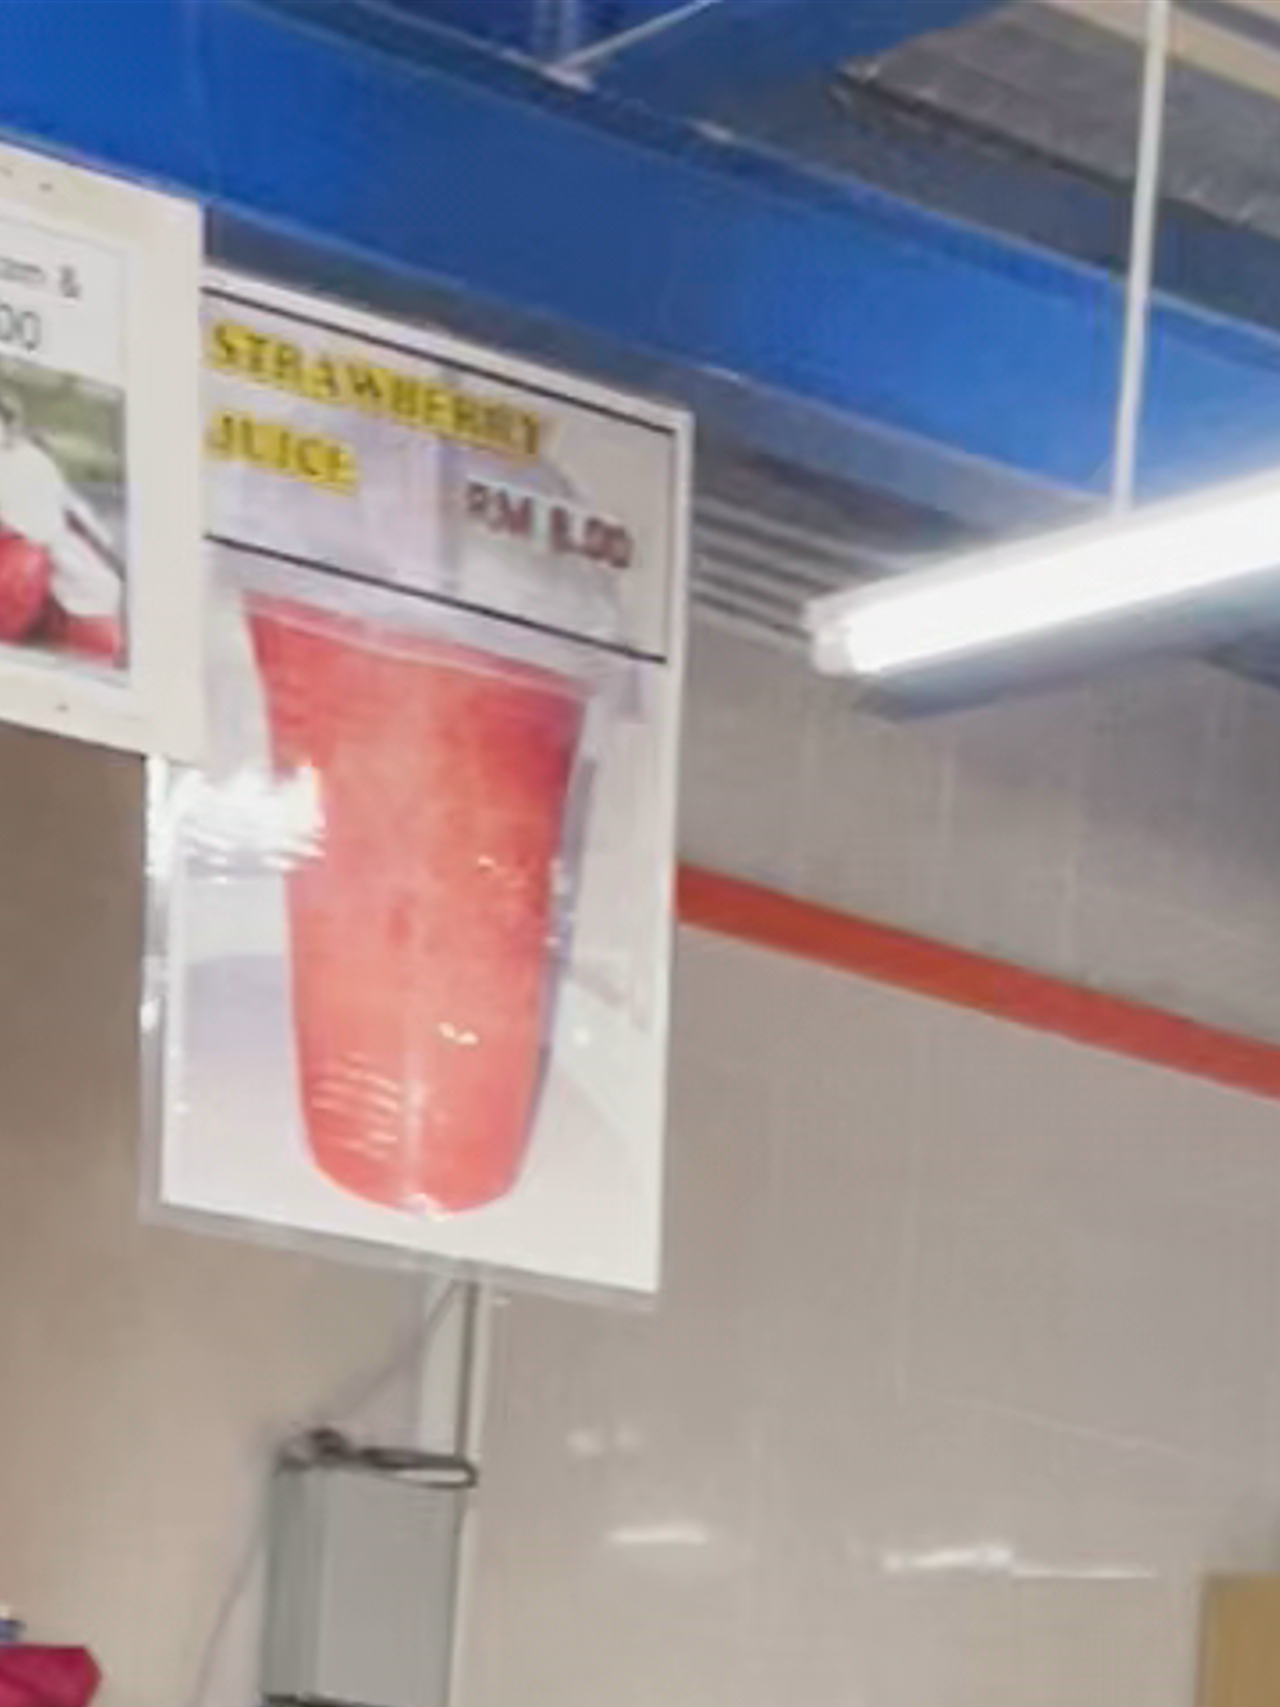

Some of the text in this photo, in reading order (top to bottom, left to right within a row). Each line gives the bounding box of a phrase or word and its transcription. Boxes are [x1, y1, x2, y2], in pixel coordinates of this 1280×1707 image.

[58, 265, 82, 300] &
[210, 323, 542, 457] STRAWBERRY
[208, 412, 356, 488] JUICE
[466, 482, 532, 540] RM
